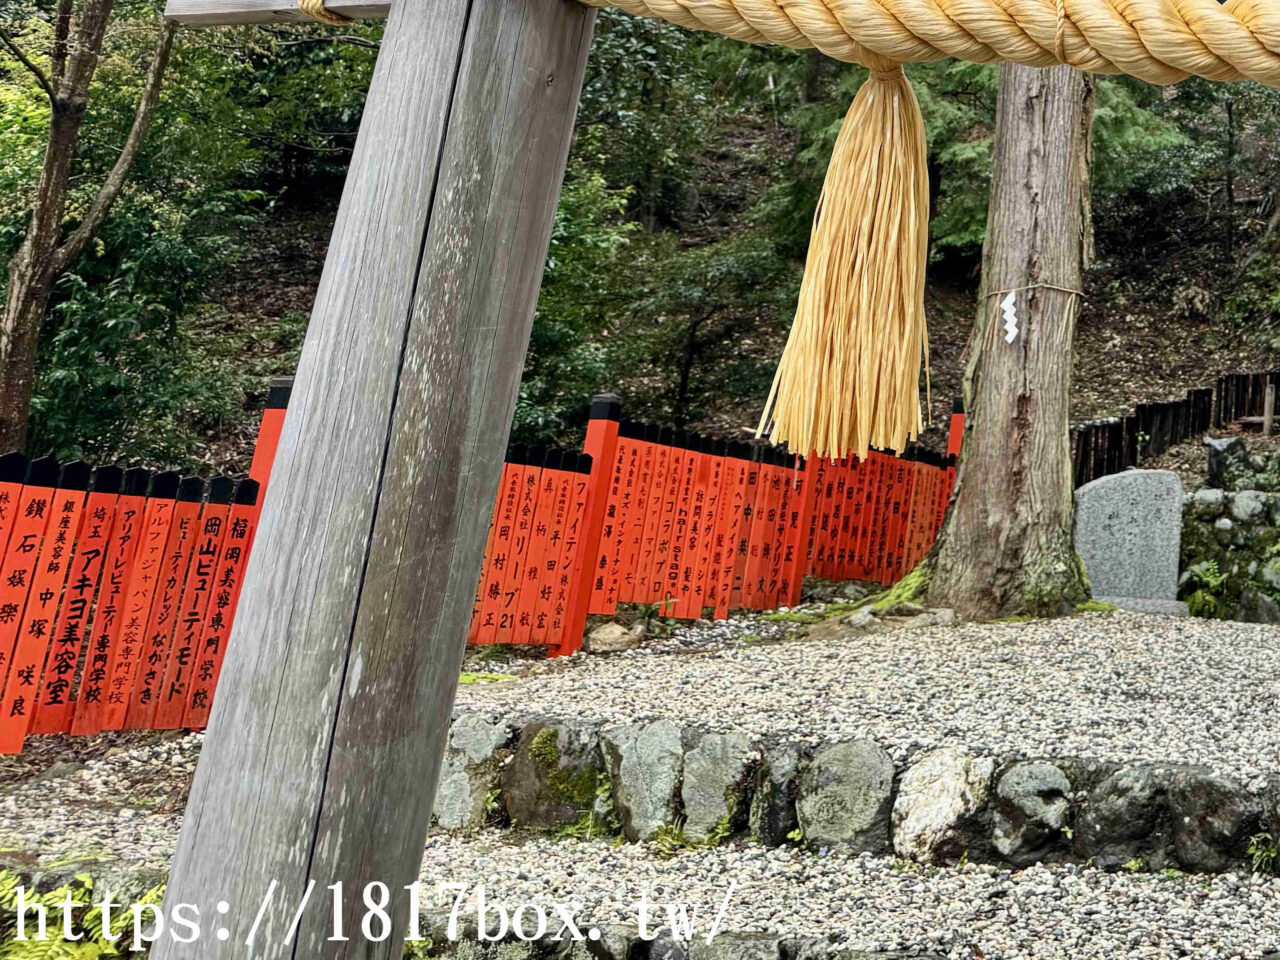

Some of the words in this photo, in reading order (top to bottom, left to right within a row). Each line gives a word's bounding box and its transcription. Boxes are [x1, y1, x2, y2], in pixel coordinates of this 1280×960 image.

[44, 507, 107, 706] 埼玉アキヨ美容室
[191, 517, 248, 710] 福岡美容専門学校
[500, 474, 536, 629] 株式会社リーブ21
[552, 482, 586, 629] ファイテン株式会社
